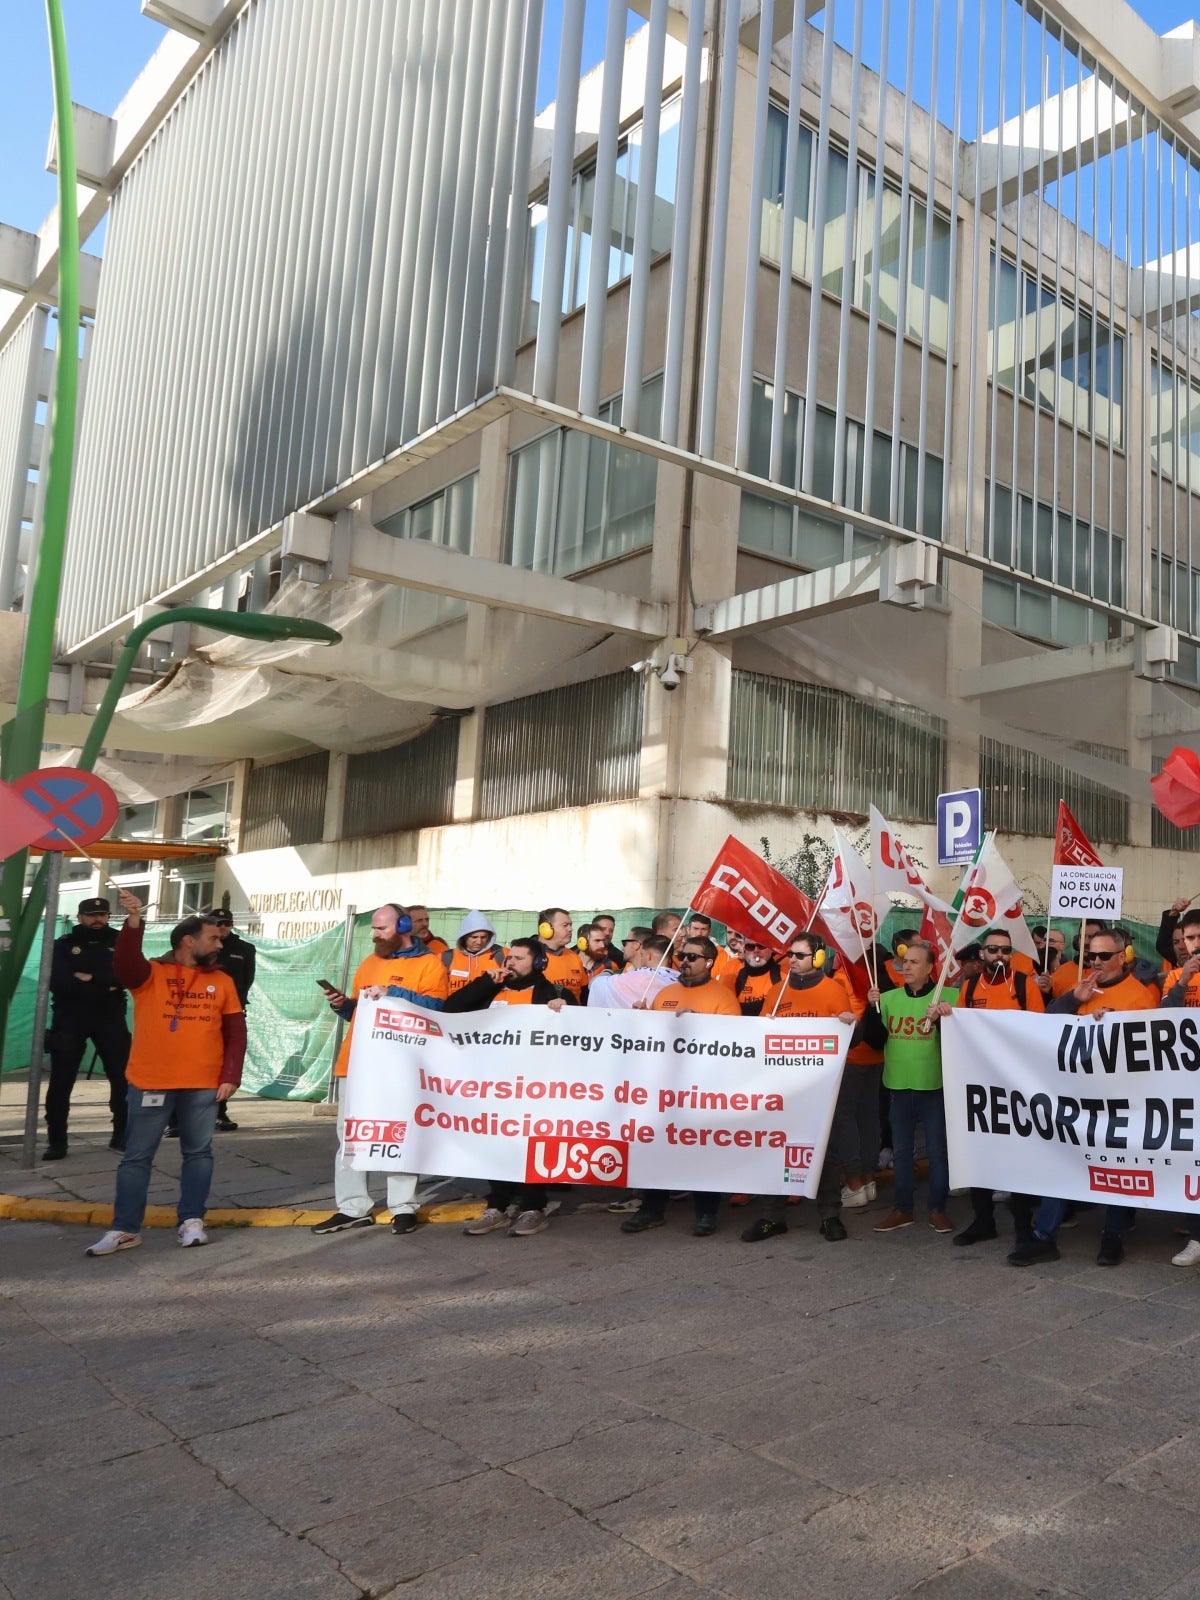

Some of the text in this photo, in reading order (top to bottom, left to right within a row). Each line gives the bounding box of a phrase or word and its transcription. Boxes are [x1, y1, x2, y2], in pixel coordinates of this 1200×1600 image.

[946, 801, 971, 856] P
[1060, 881, 1116, 892] NO ES UNA
[249, 889, 342, 913] SUBDELEGACION
[710, 864, 797, 944] CCOO
[1058, 894, 1115, 910] OPCIÓN
[378, 1012, 427, 1031] CCOO
[889, 1016, 934, 1036] USO
[371, 1028, 427, 1046] industria
[449, 1030, 756, 1058] Hitachi Energy Spain Córdoba
[768, 1038, 820, 1051] CCOO
[764, 1054, 824, 1066] industria
[419, 1068, 784, 1119] Inversiones de primera
[414, 1103, 786, 1149] Condiciones de tercera
[966, 1084, 1131, 1149] RECORTE
[1143, 1098, 1194, 1152] DE
[344, 1121, 390, 1140] UGT
[369, 1144, 401, 1158] FIC
[1085, 1153, 1172, 1166] COMITE
[534, 1141, 624, 1181] USO
[1093, 1172, 1150, 1191] CCOO
